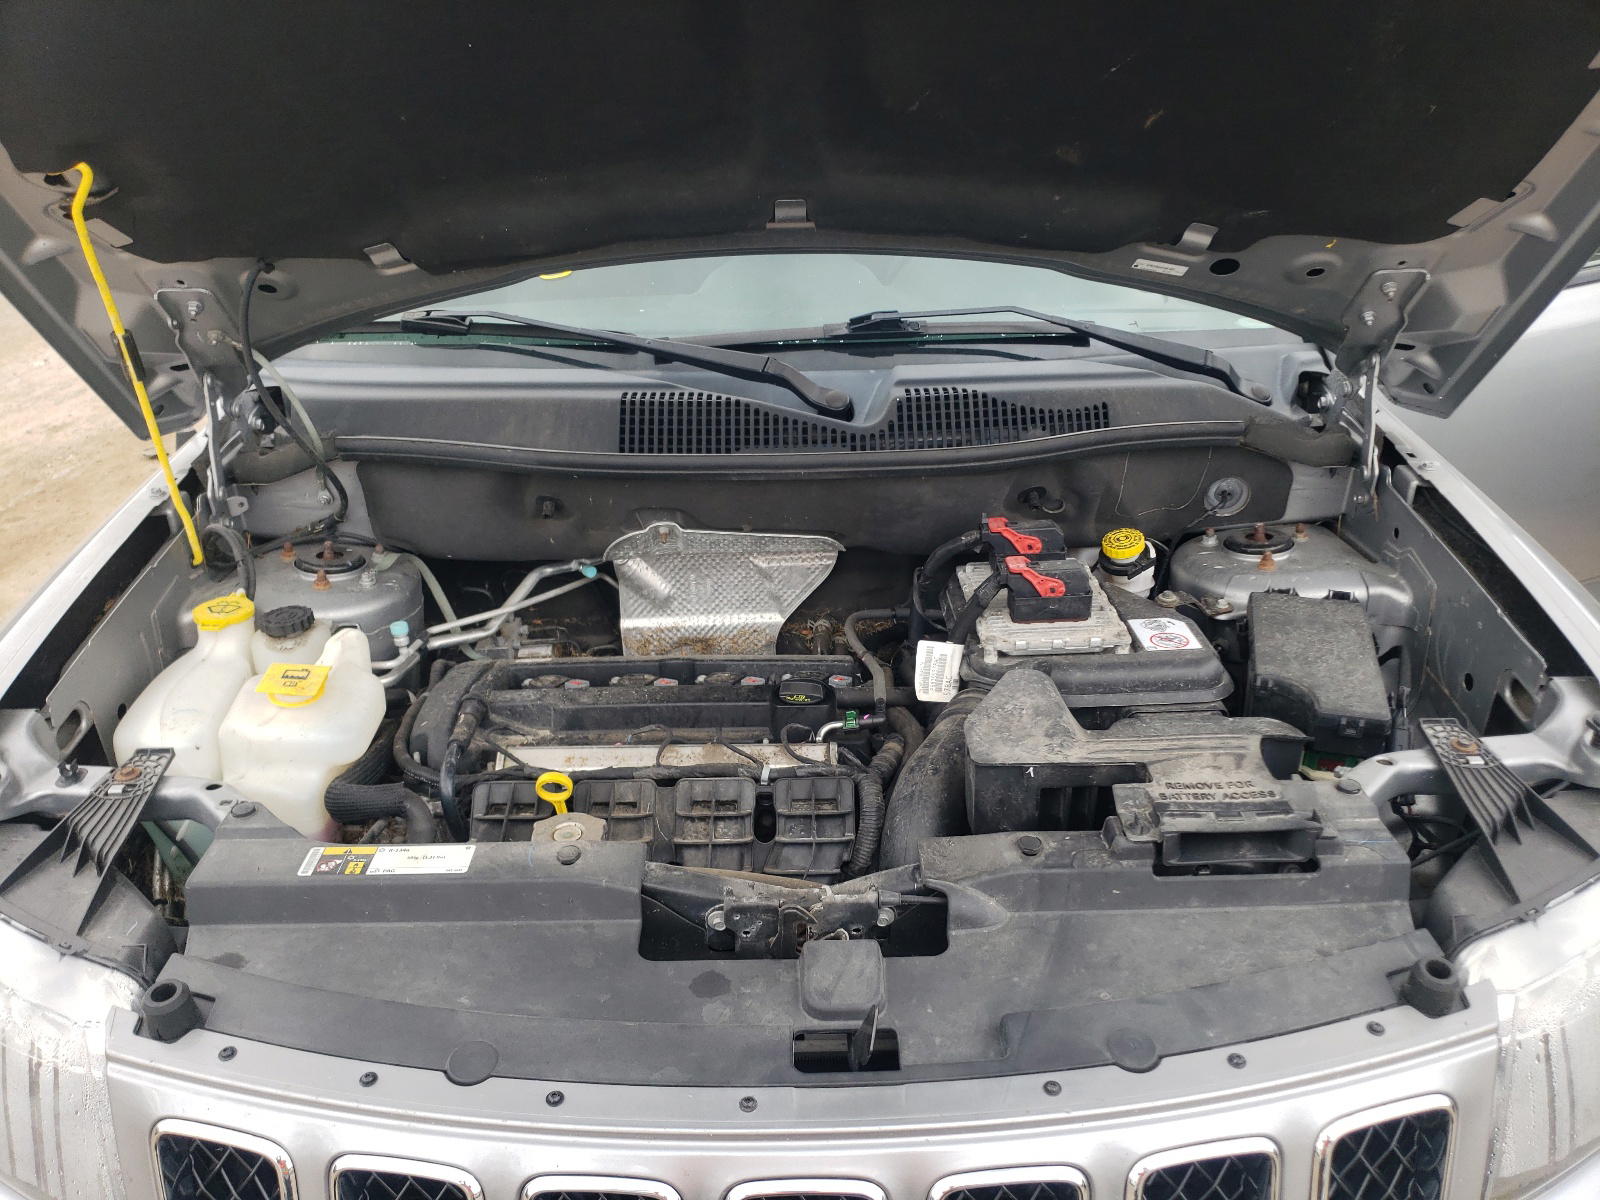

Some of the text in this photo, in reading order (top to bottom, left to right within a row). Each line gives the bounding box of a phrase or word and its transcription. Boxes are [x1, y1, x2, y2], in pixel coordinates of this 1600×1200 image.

[1164, 780, 1257, 790] REMOVE FOR
[1158, 790, 1277, 801] BATTERY ACCESS
